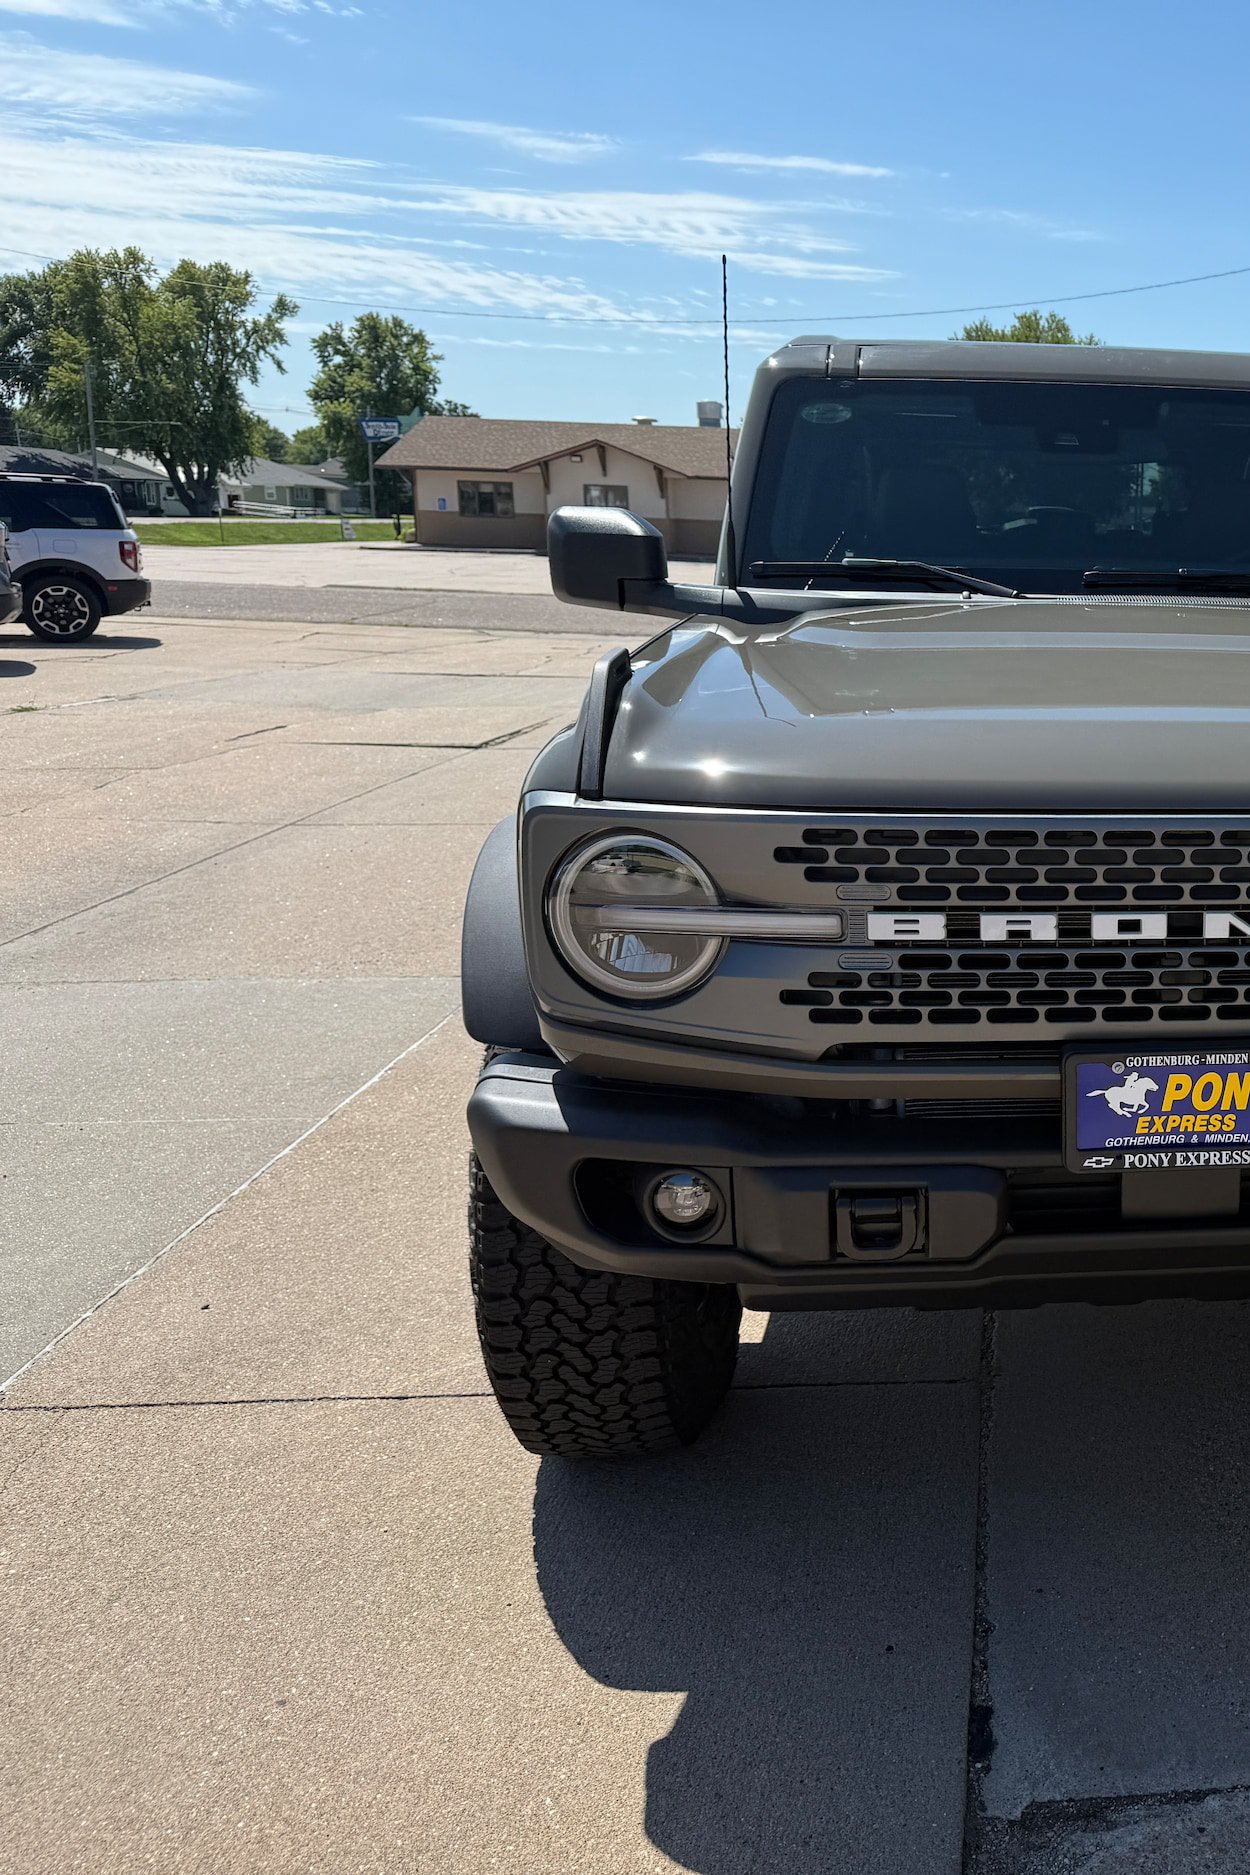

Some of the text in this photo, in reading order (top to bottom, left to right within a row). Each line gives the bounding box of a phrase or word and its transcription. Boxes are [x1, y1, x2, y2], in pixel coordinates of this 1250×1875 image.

[1125, 1052, 1249, 1068] GOTHENBURG-MINDEN
[1135, 1113, 1237, 1135] EXPRESS
[1104, 1133, 1186, 1148] GOTHENBURG
[1190, 1133, 1199, 1144] &
[1204, 1132, 1250, 1144] MINDEN,
[1123, 1149, 1250, 1169] PONY EXPRESS
